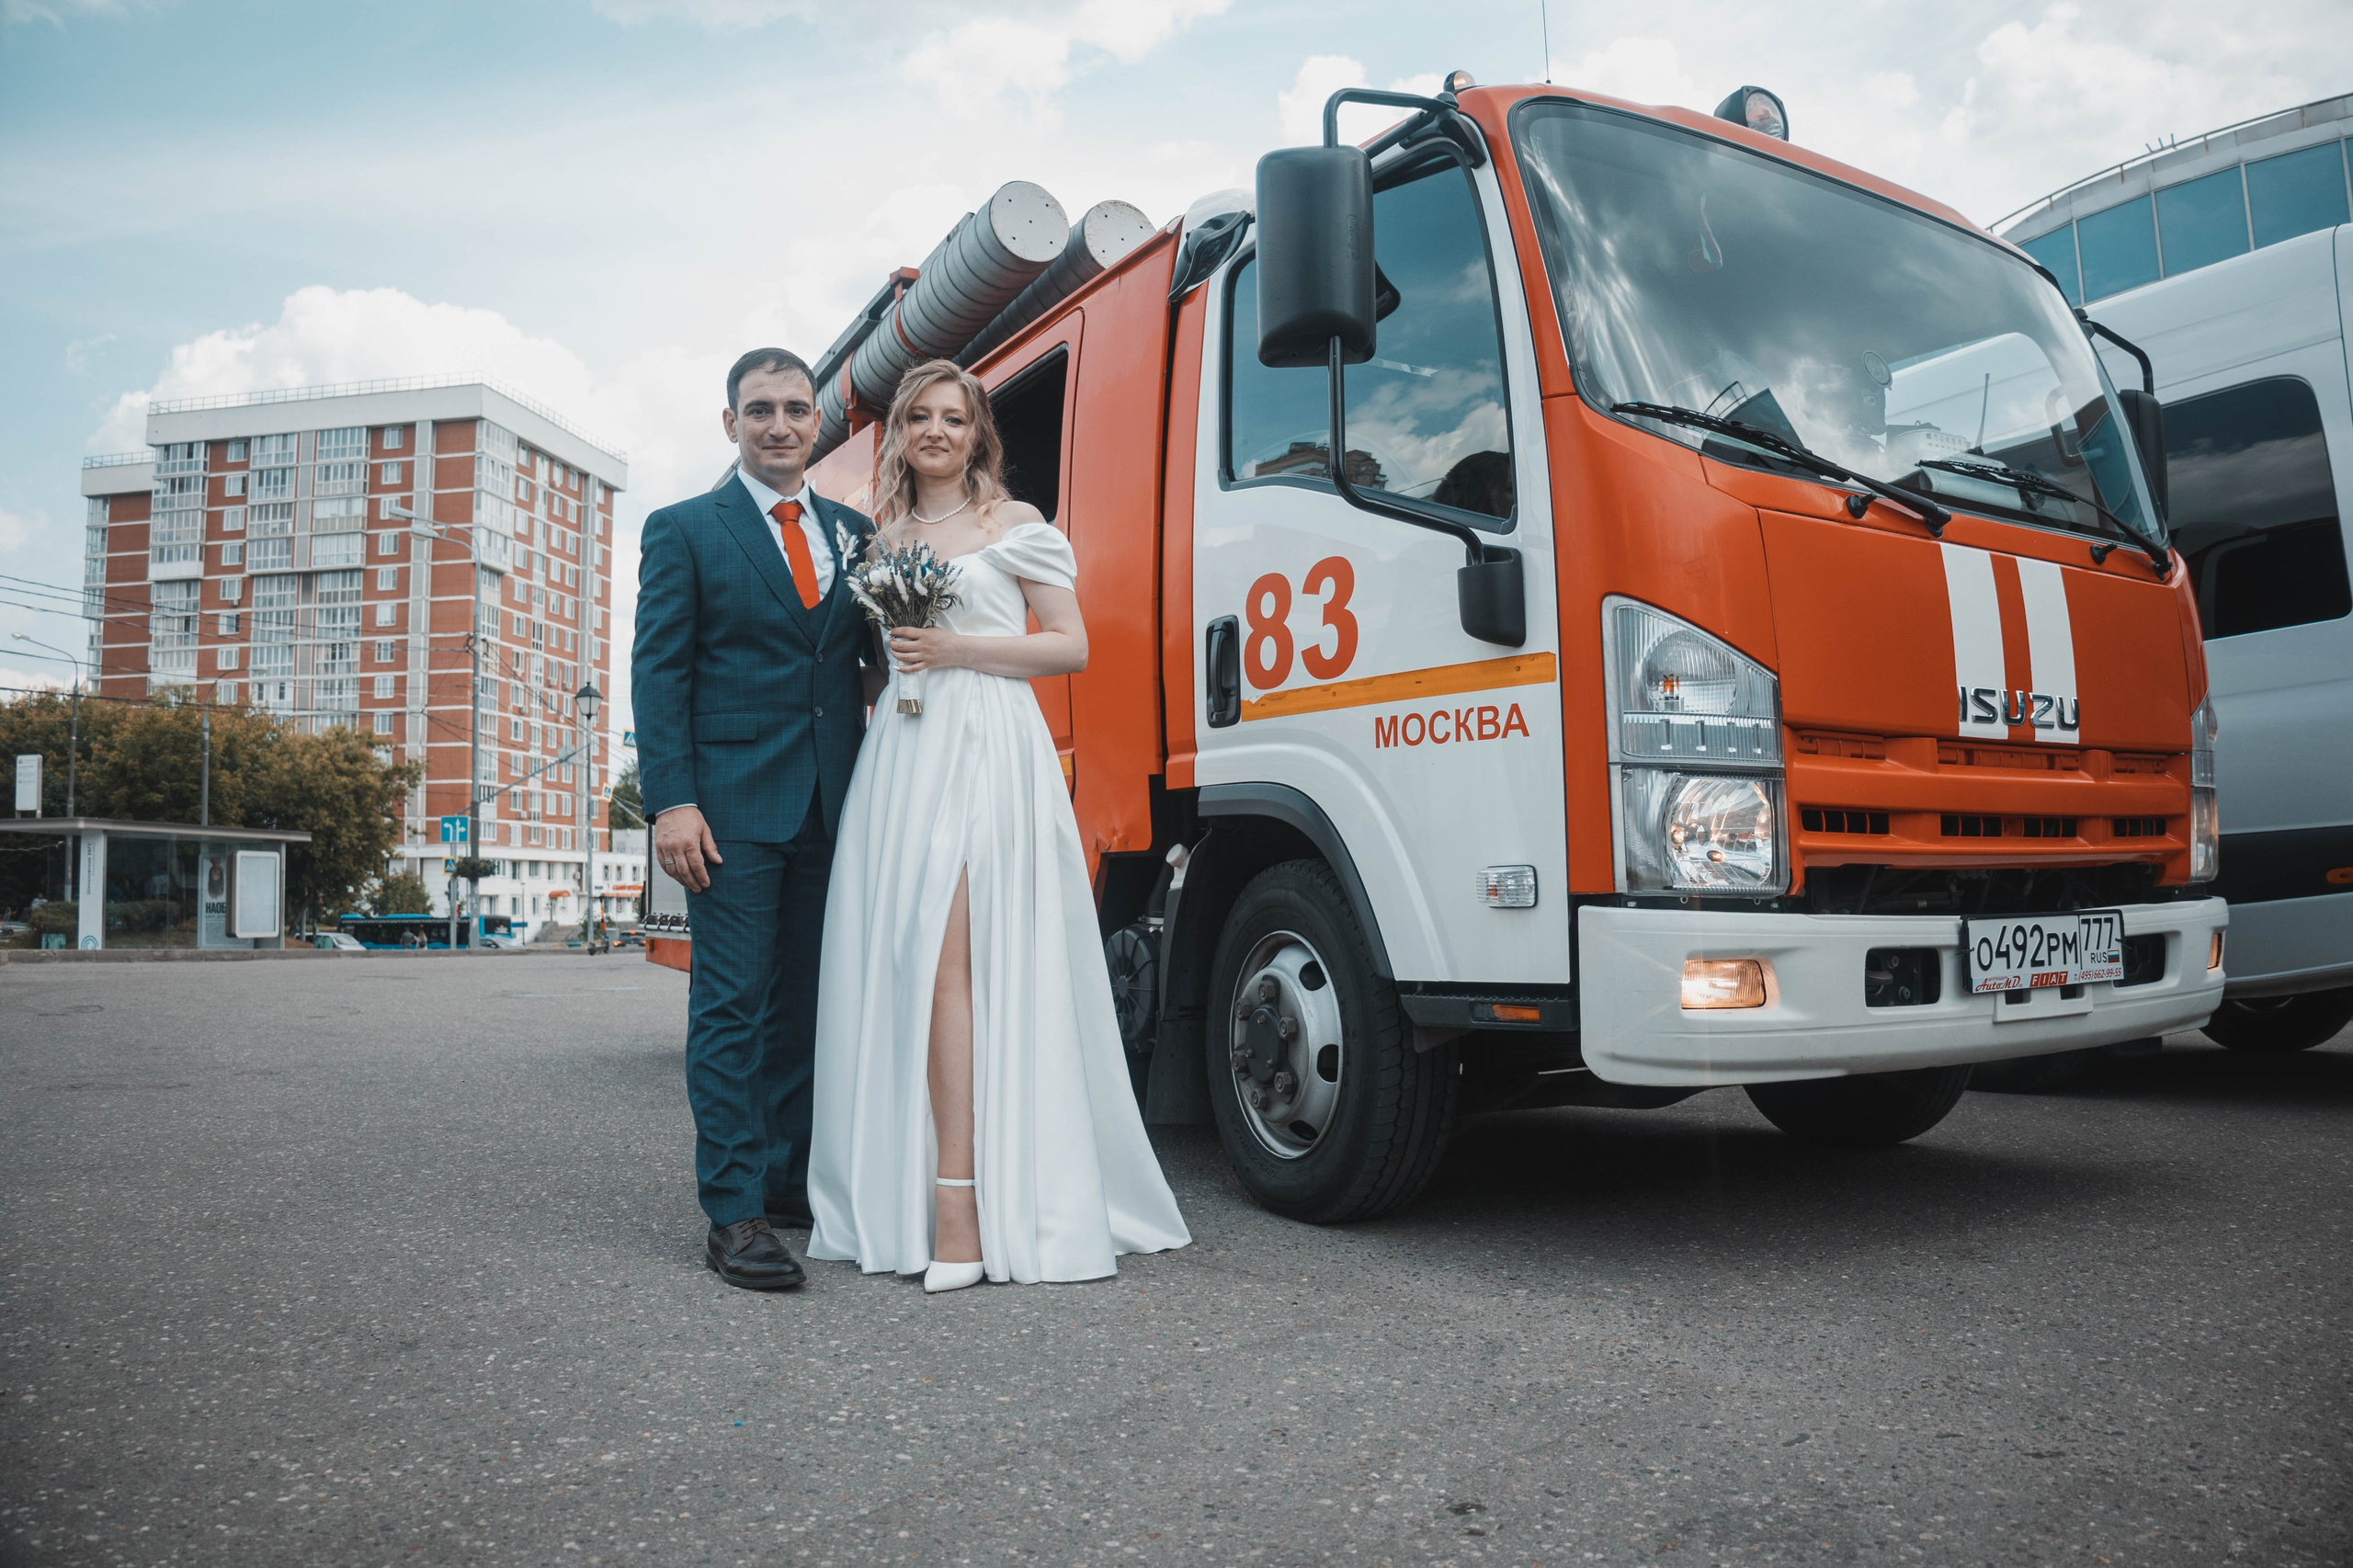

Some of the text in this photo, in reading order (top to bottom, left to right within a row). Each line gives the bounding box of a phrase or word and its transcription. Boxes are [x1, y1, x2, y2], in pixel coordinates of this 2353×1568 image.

[1244, 556, 1358, 689] 83
[1375, 703, 1529, 748] МОСКВА
[1957, 685, 2079, 731] ISUZU
[2081, 917, 2114, 950] 777
[2091, 950, 2108, 963] RUS
[2030, 971, 2067, 986] FIAT
